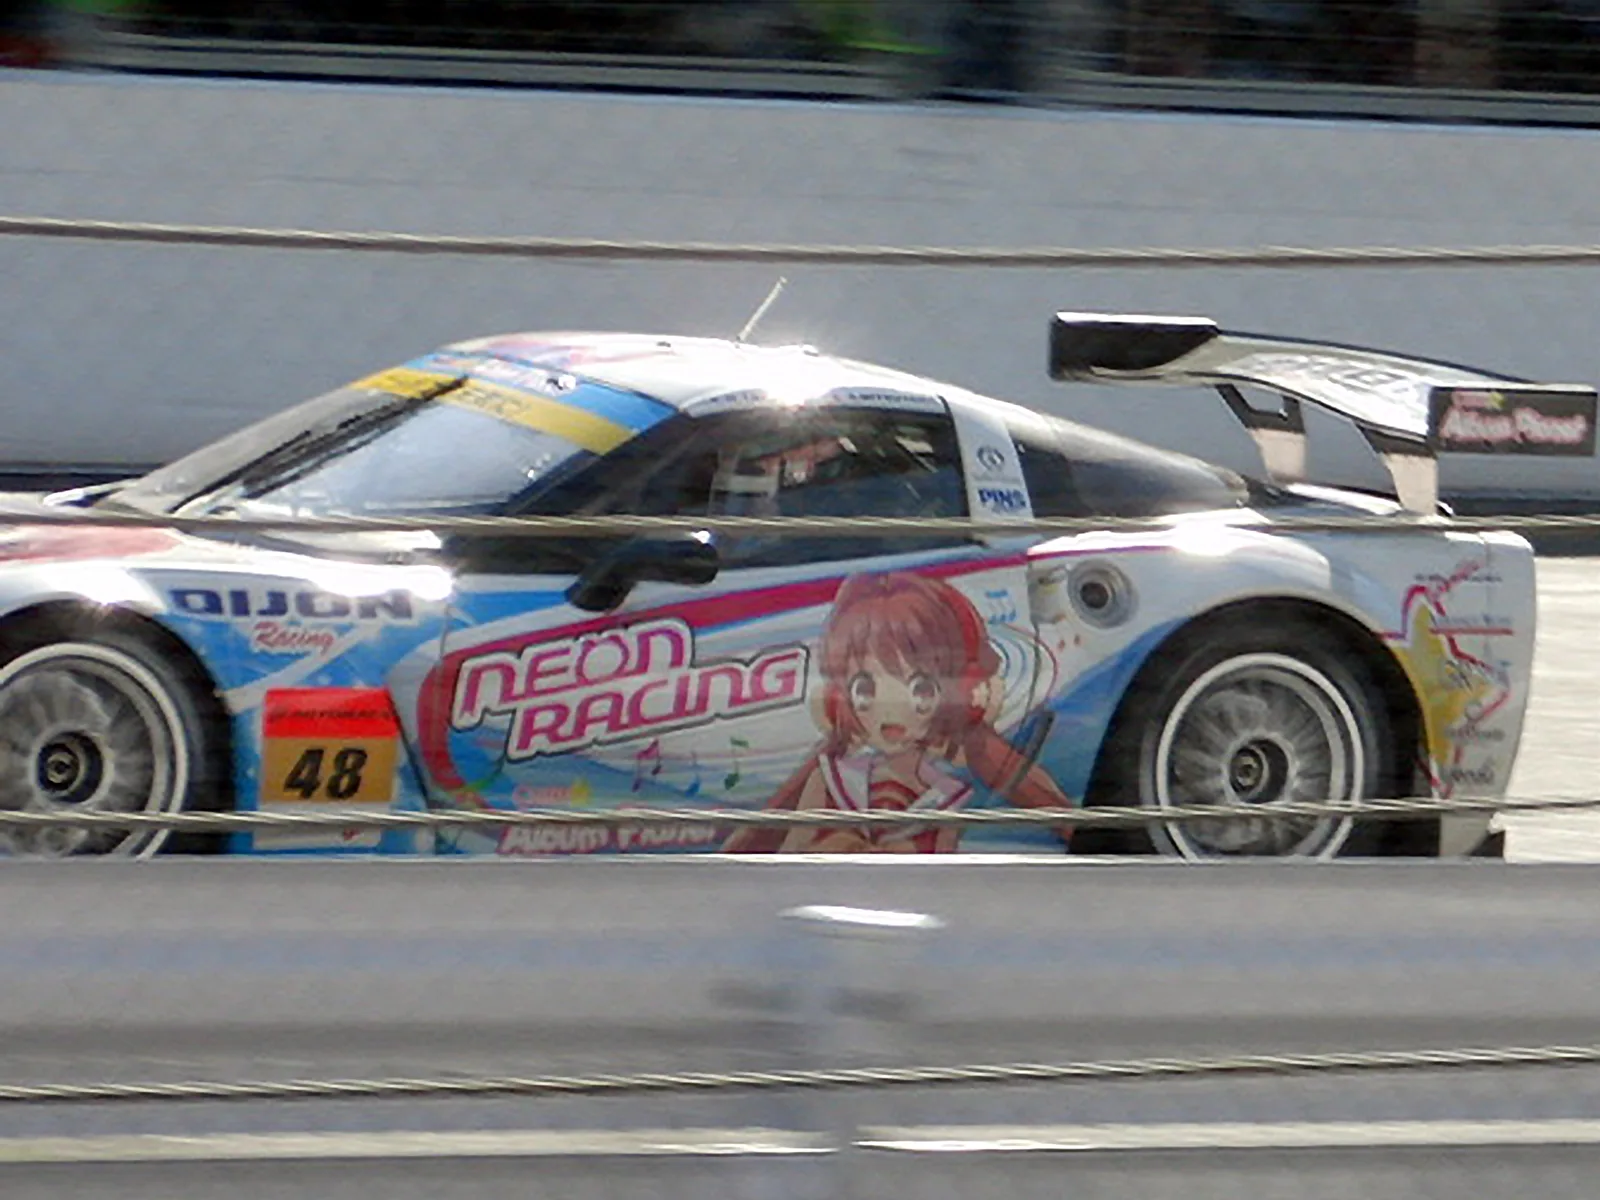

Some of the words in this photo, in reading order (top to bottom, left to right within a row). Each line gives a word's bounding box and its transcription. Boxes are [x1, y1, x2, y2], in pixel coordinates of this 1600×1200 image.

[254, 621, 335, 655] Racing
[460, 625, 687, 720] NEON
[513, 649, 803, 755] RACING
[283, 747, 368, 800] 48
